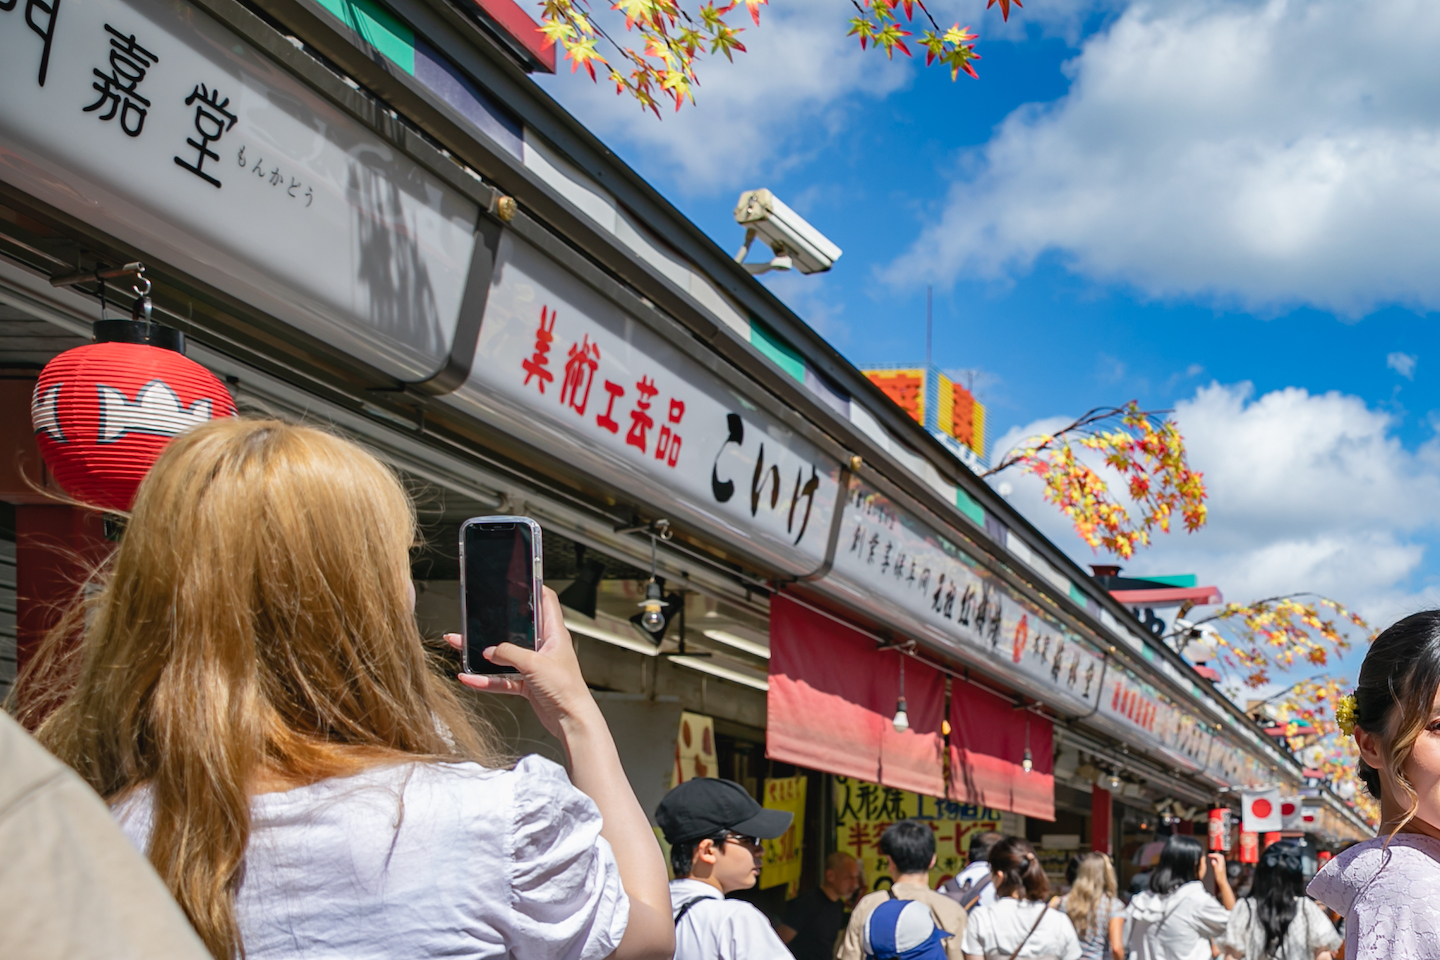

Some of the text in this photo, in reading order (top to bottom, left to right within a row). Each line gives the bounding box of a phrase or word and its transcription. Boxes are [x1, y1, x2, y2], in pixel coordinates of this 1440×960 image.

[237, 145, 314, 207] もんかどう
[522, 304, 686, 467] 美術工芸品
[711, 412, 819, 546] こいけ
[840, 783, 907, 820] 人形焼
